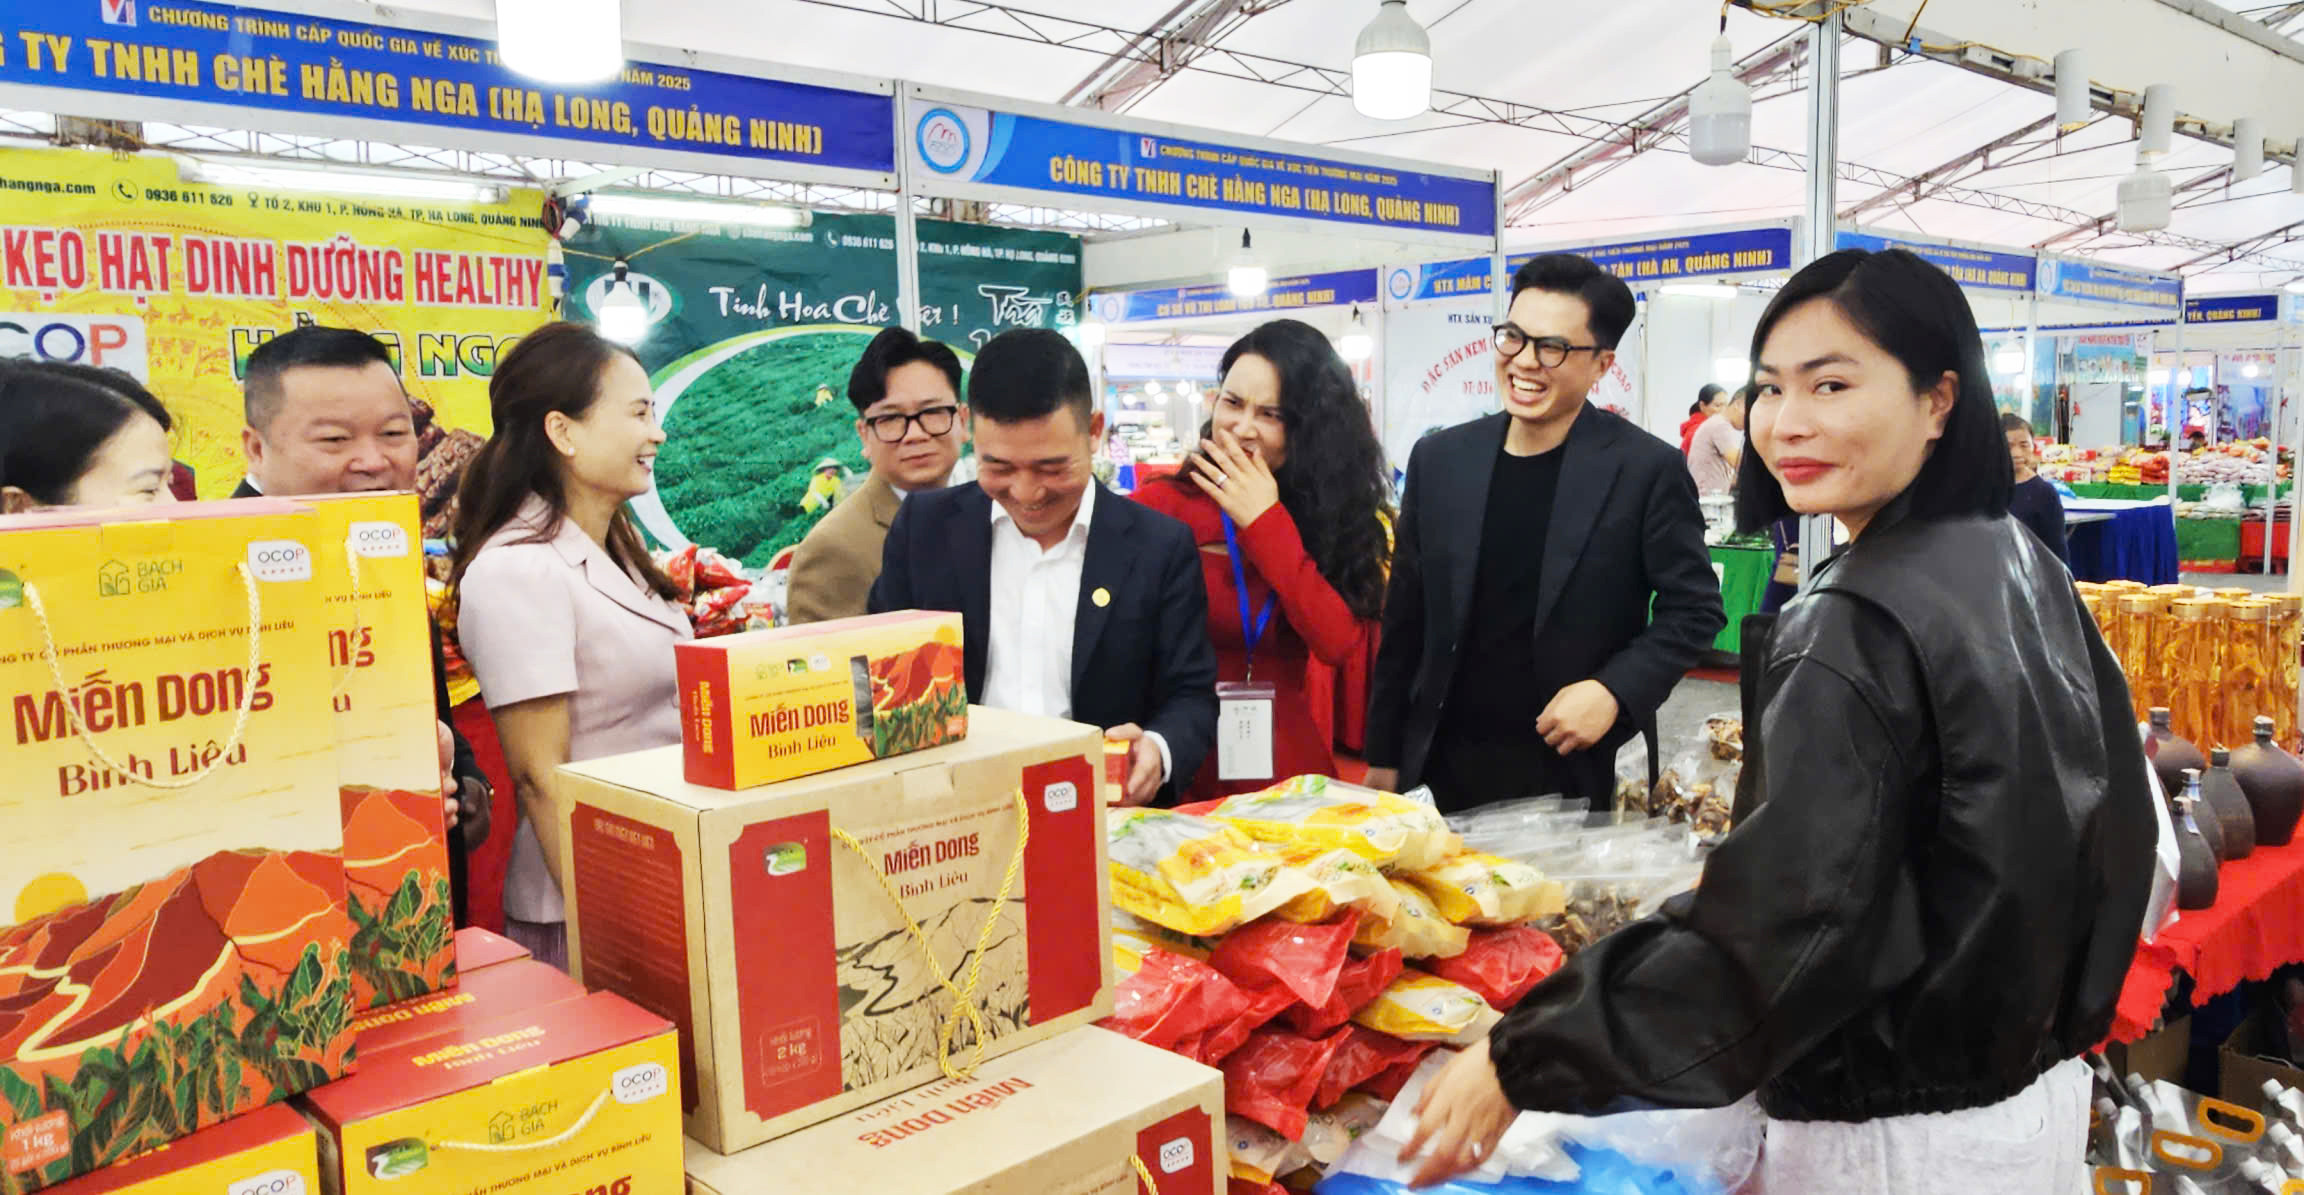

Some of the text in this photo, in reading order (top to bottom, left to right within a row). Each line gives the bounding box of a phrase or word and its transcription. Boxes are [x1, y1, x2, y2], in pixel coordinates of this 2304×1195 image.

[149, 6, 229, 32] CHƯƠNG
[235, 15, 292, 39] TRÌNH
[296, 21, 333, 44] CẤP
[337, 28, 385, 50] QUỐC
[389, 37, 418, 55] GIA
[422, 38, 444, 59] VỀ
[448, 43, 480, 65] XÚC
[657, 73, 691, 91] 2025
[18, 31, 72, 73] TY
[86, 39, 200, 87] TNHH
[213, 53, 289, 96] CHÈ
[300, 56, 400, 109] HẰNG
[411, 76, 479, 118] NGA
[488, 86, 546, 130] (HẠ
[555, 94, 639, 138] LONG,
[647, 103, 742, 147] QUẢNG
[749, 118, 823, 155] NINH)
[181, 190, 205, 204] 611
[282, 198, 295, 213] 2,
[297, 200, 322, 214] KHU
[326, 202, 337, 217] 1,
[339, 204, 349, 217] P.
[480, 211, 517, 227] QUẢNG
[1050, 153, 1460, 227] CÔNG TY TNHH CHÈ HẰNG NGA (HẠ LONG, QUẢNG NINH)
[3, 227, 543, 307] KẸO HẠT DINH DƯỠNG HEALTHY
[1685, 251, 1730, 273] QUẢNG
[1733, 249, 1773, 268] NINH)
[777, 290, 832, 322] Hoa
[832, 288, 890, 324] Chè
[359, 528, 401, 542] OCOP
[257, 548, 305, 564] OCOP
[138, 577, 168, 593] GIA
[21, 652, 34, 662] TY
[198, 628, 226, 643] DỊCH
[229, 625, 244, 640] VỤ
[13, 661, 274, 745] Miến Dong
[750, 699, 850, 738] Miến Dong
[168, 739, 248, 777] Liêu
[884, 837, 931, 877] Miến
[935, 831, 981, 864] Dong
[777, 1045, 787, 1060] 2
[621, 1067, 662, 1089] OCOP
[520, 1120, 545, 1136] GIA
[858, 1077, 1035, 1148] Miến Dong
